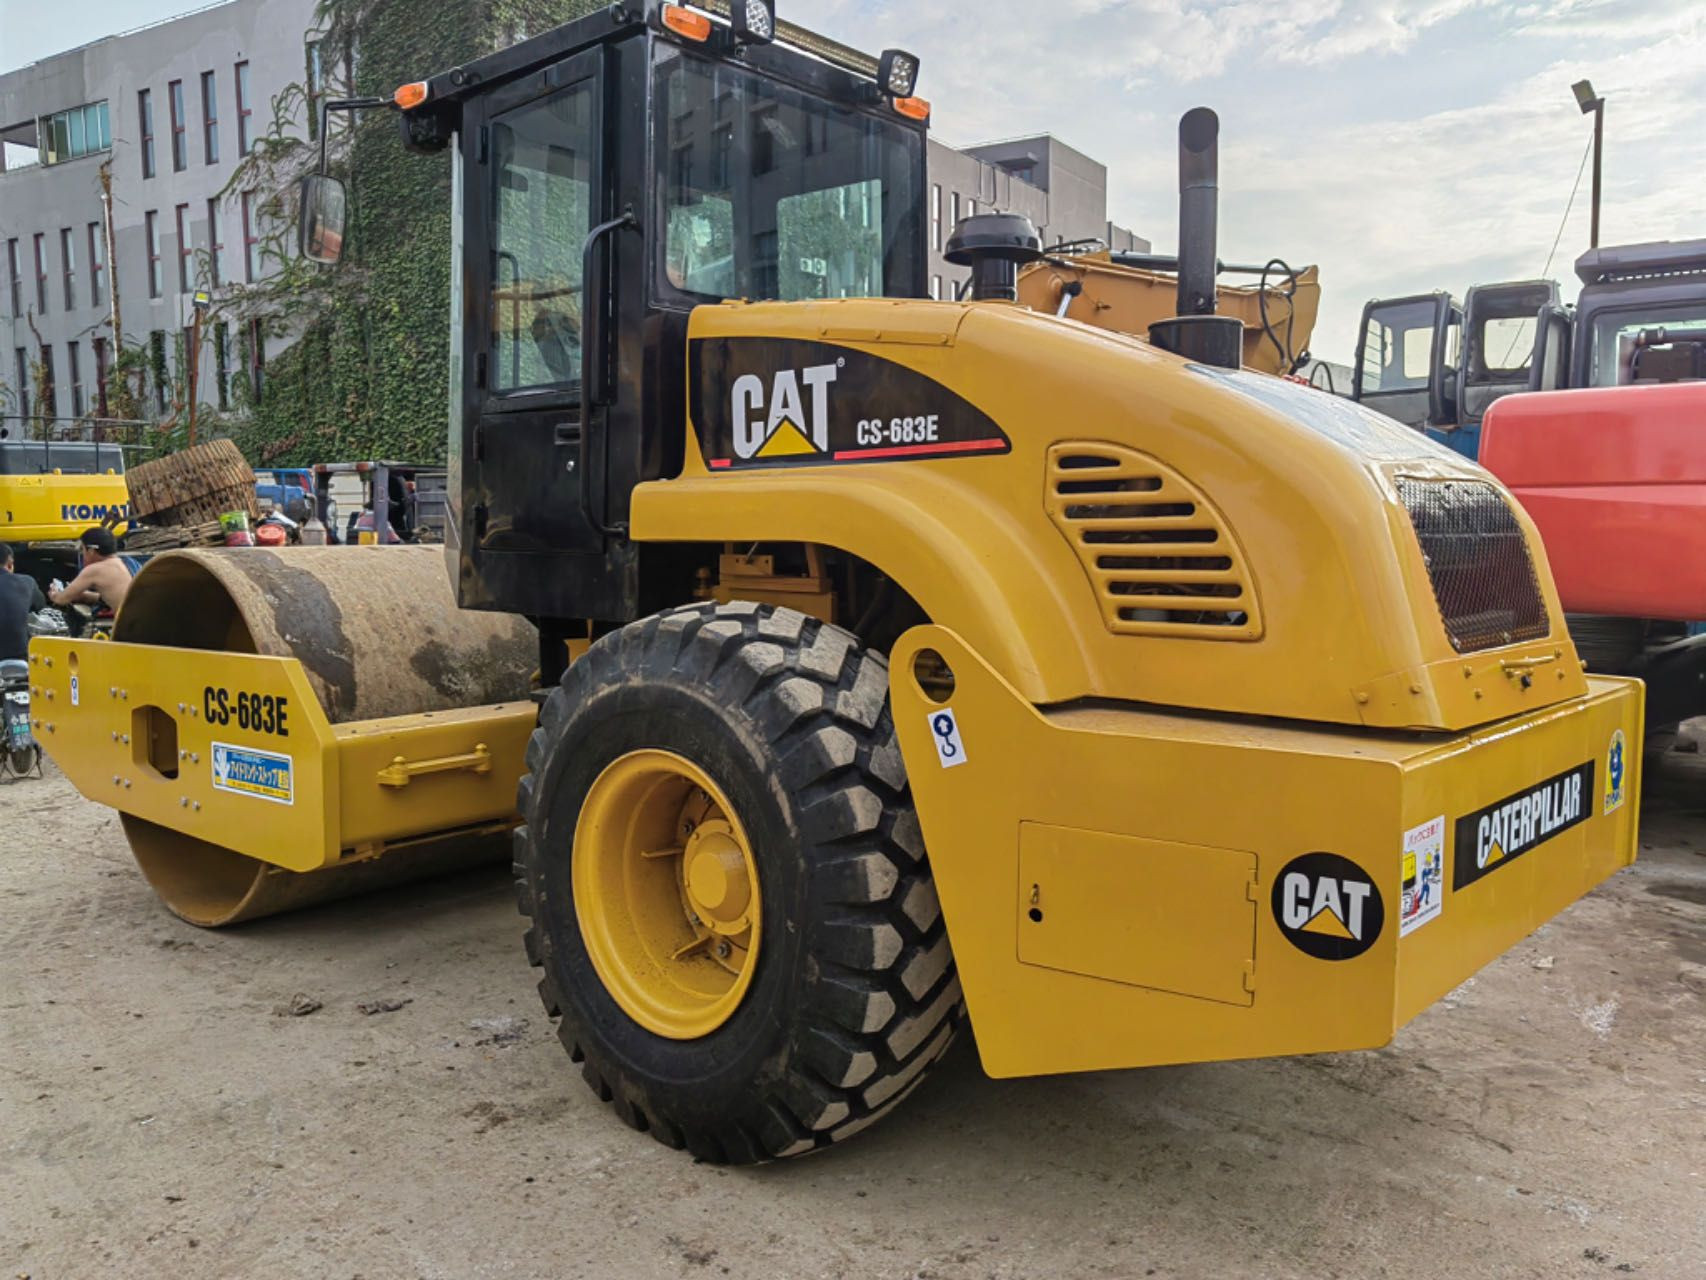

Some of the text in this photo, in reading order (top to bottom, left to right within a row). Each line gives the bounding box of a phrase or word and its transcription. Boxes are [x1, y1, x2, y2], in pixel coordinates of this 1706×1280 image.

[731, 363, 838, 460] CAT
[857, 415, 939, 446] CS-683E
[203, 686, 289, 738] CS-683E
[1476, 772, 1582, 871] CATERPILLAR
[1283, 872, 1371, 941] CAT
